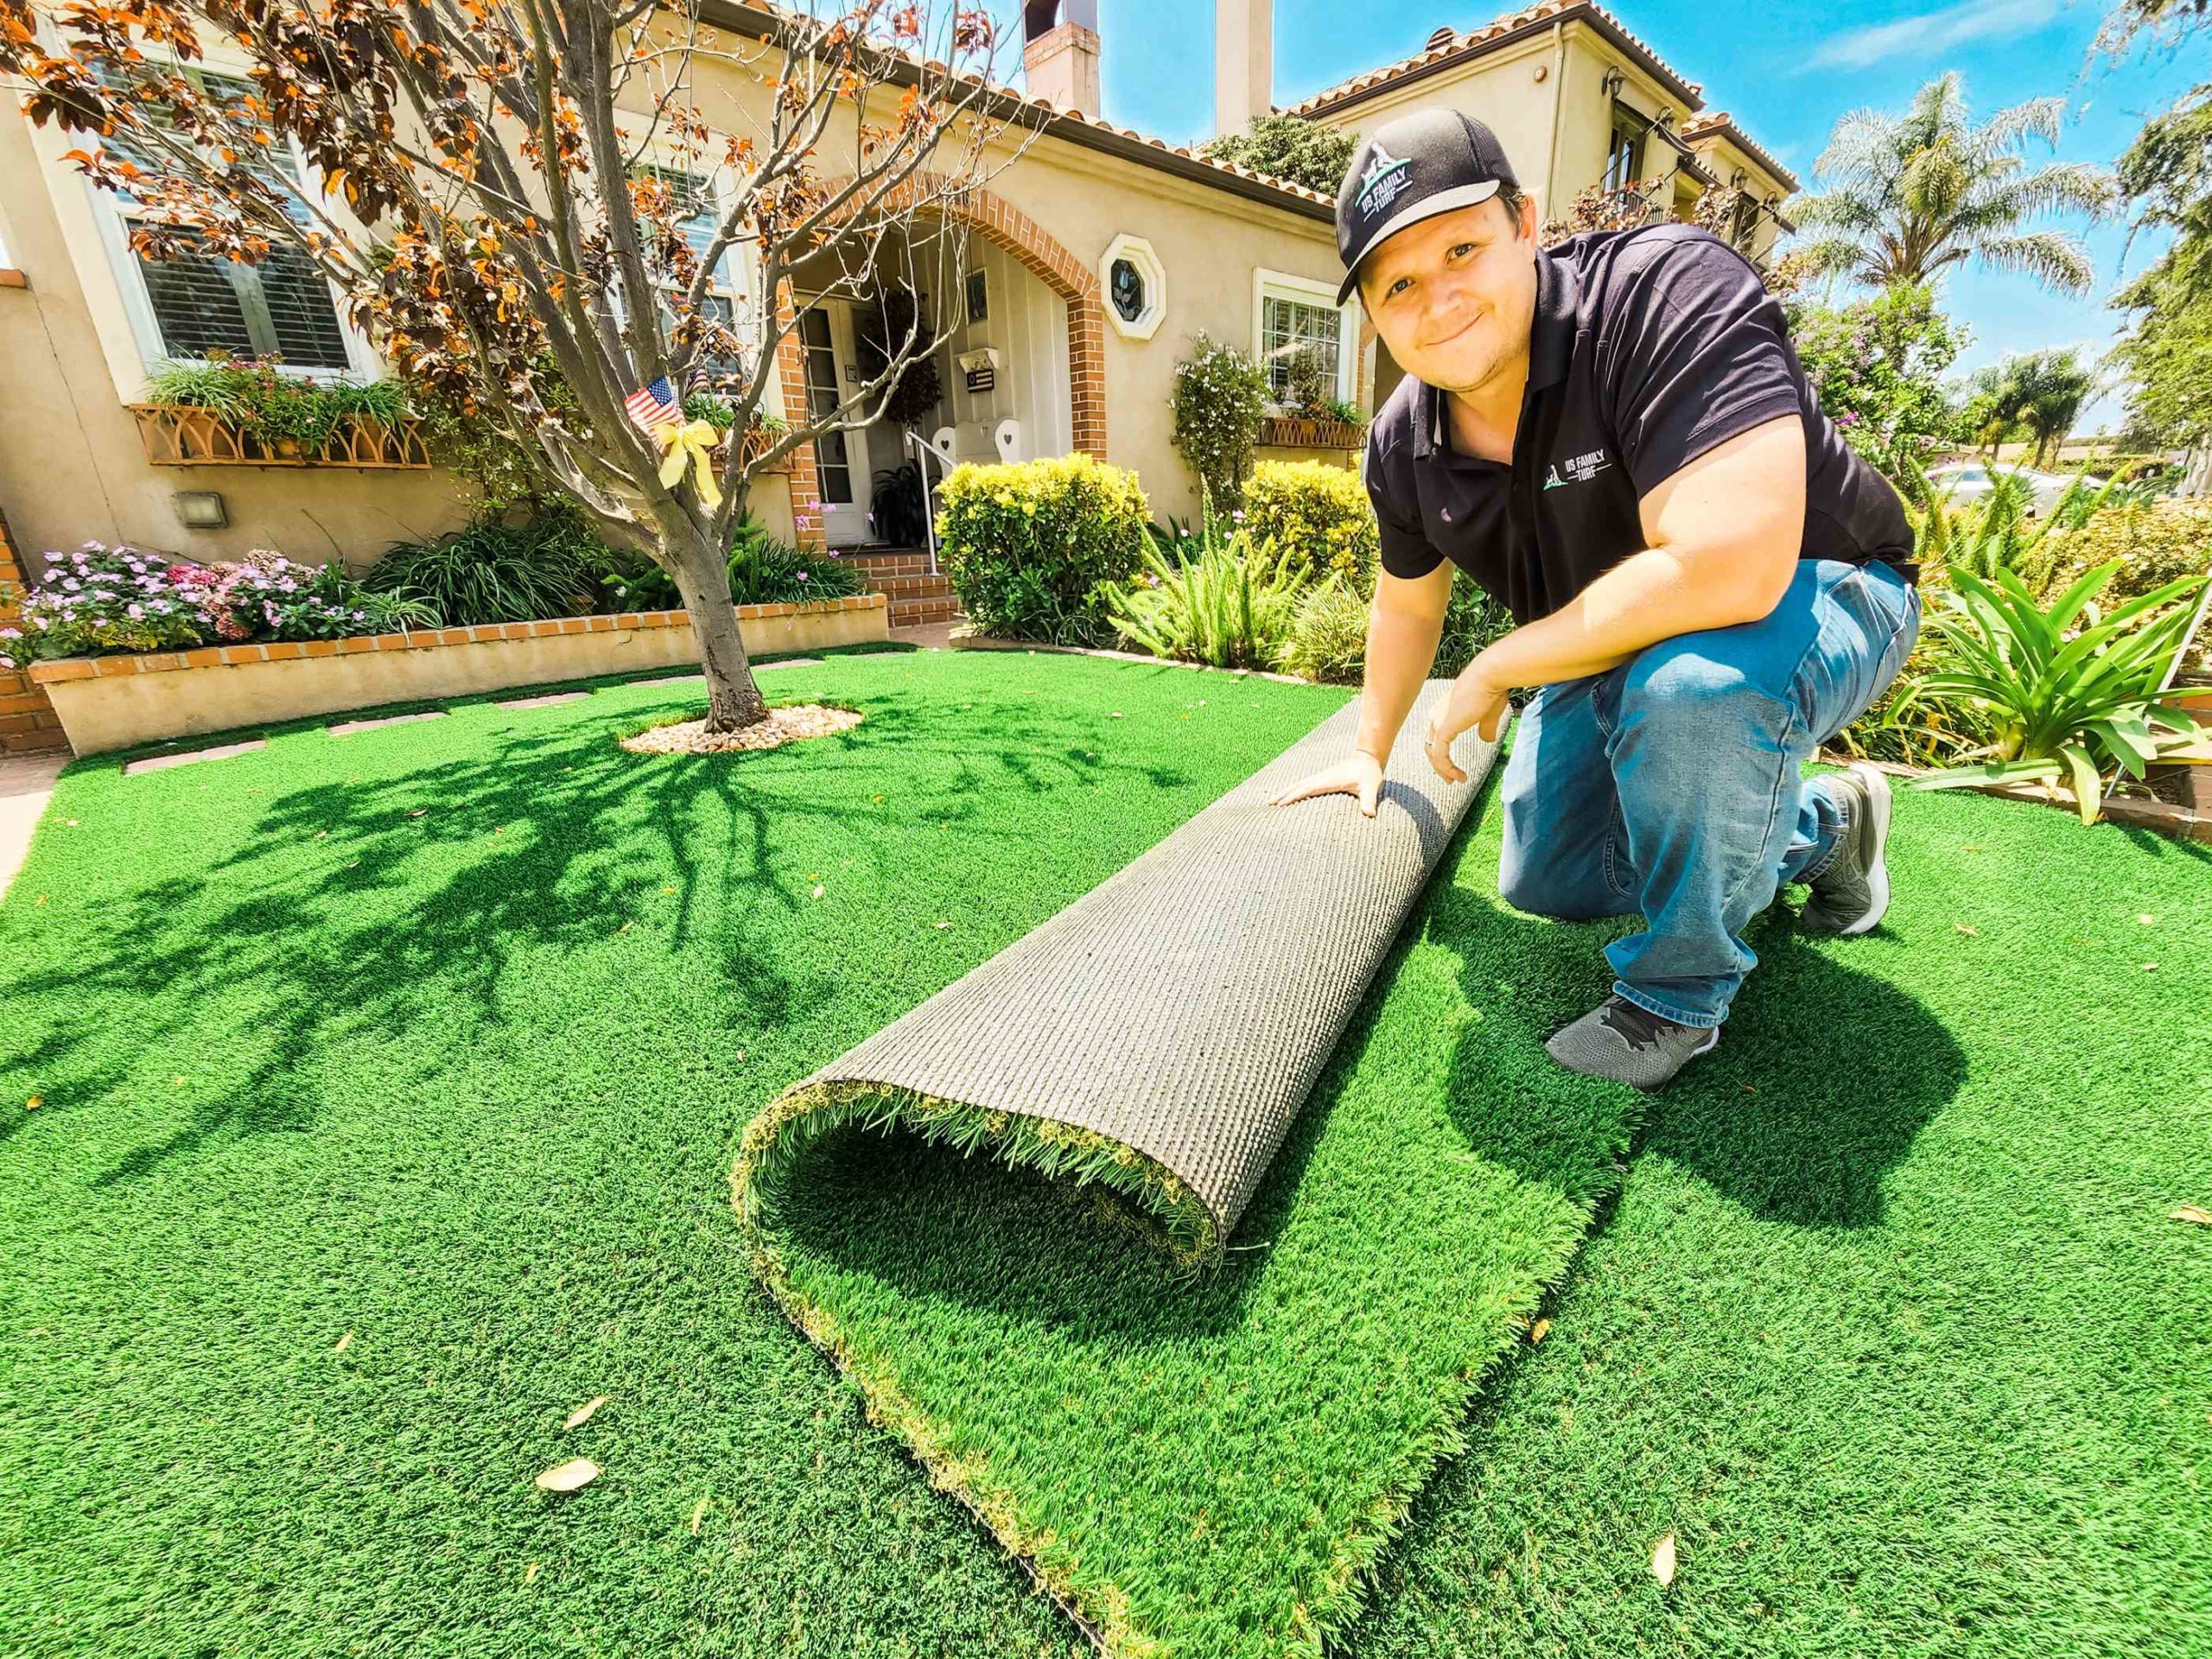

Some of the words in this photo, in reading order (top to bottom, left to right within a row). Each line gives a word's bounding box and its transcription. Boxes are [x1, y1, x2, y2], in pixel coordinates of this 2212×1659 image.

[1361, 194, 1373, 213] US
[1372, 166, 1406, 201] FAMILY
[1374, 187, 1396, 213] TURF
[1565, 459, 1576, 473] US
[1575, 448, 1605, 469] FAMILY
[1576, 465, 1596, 482] TURF
